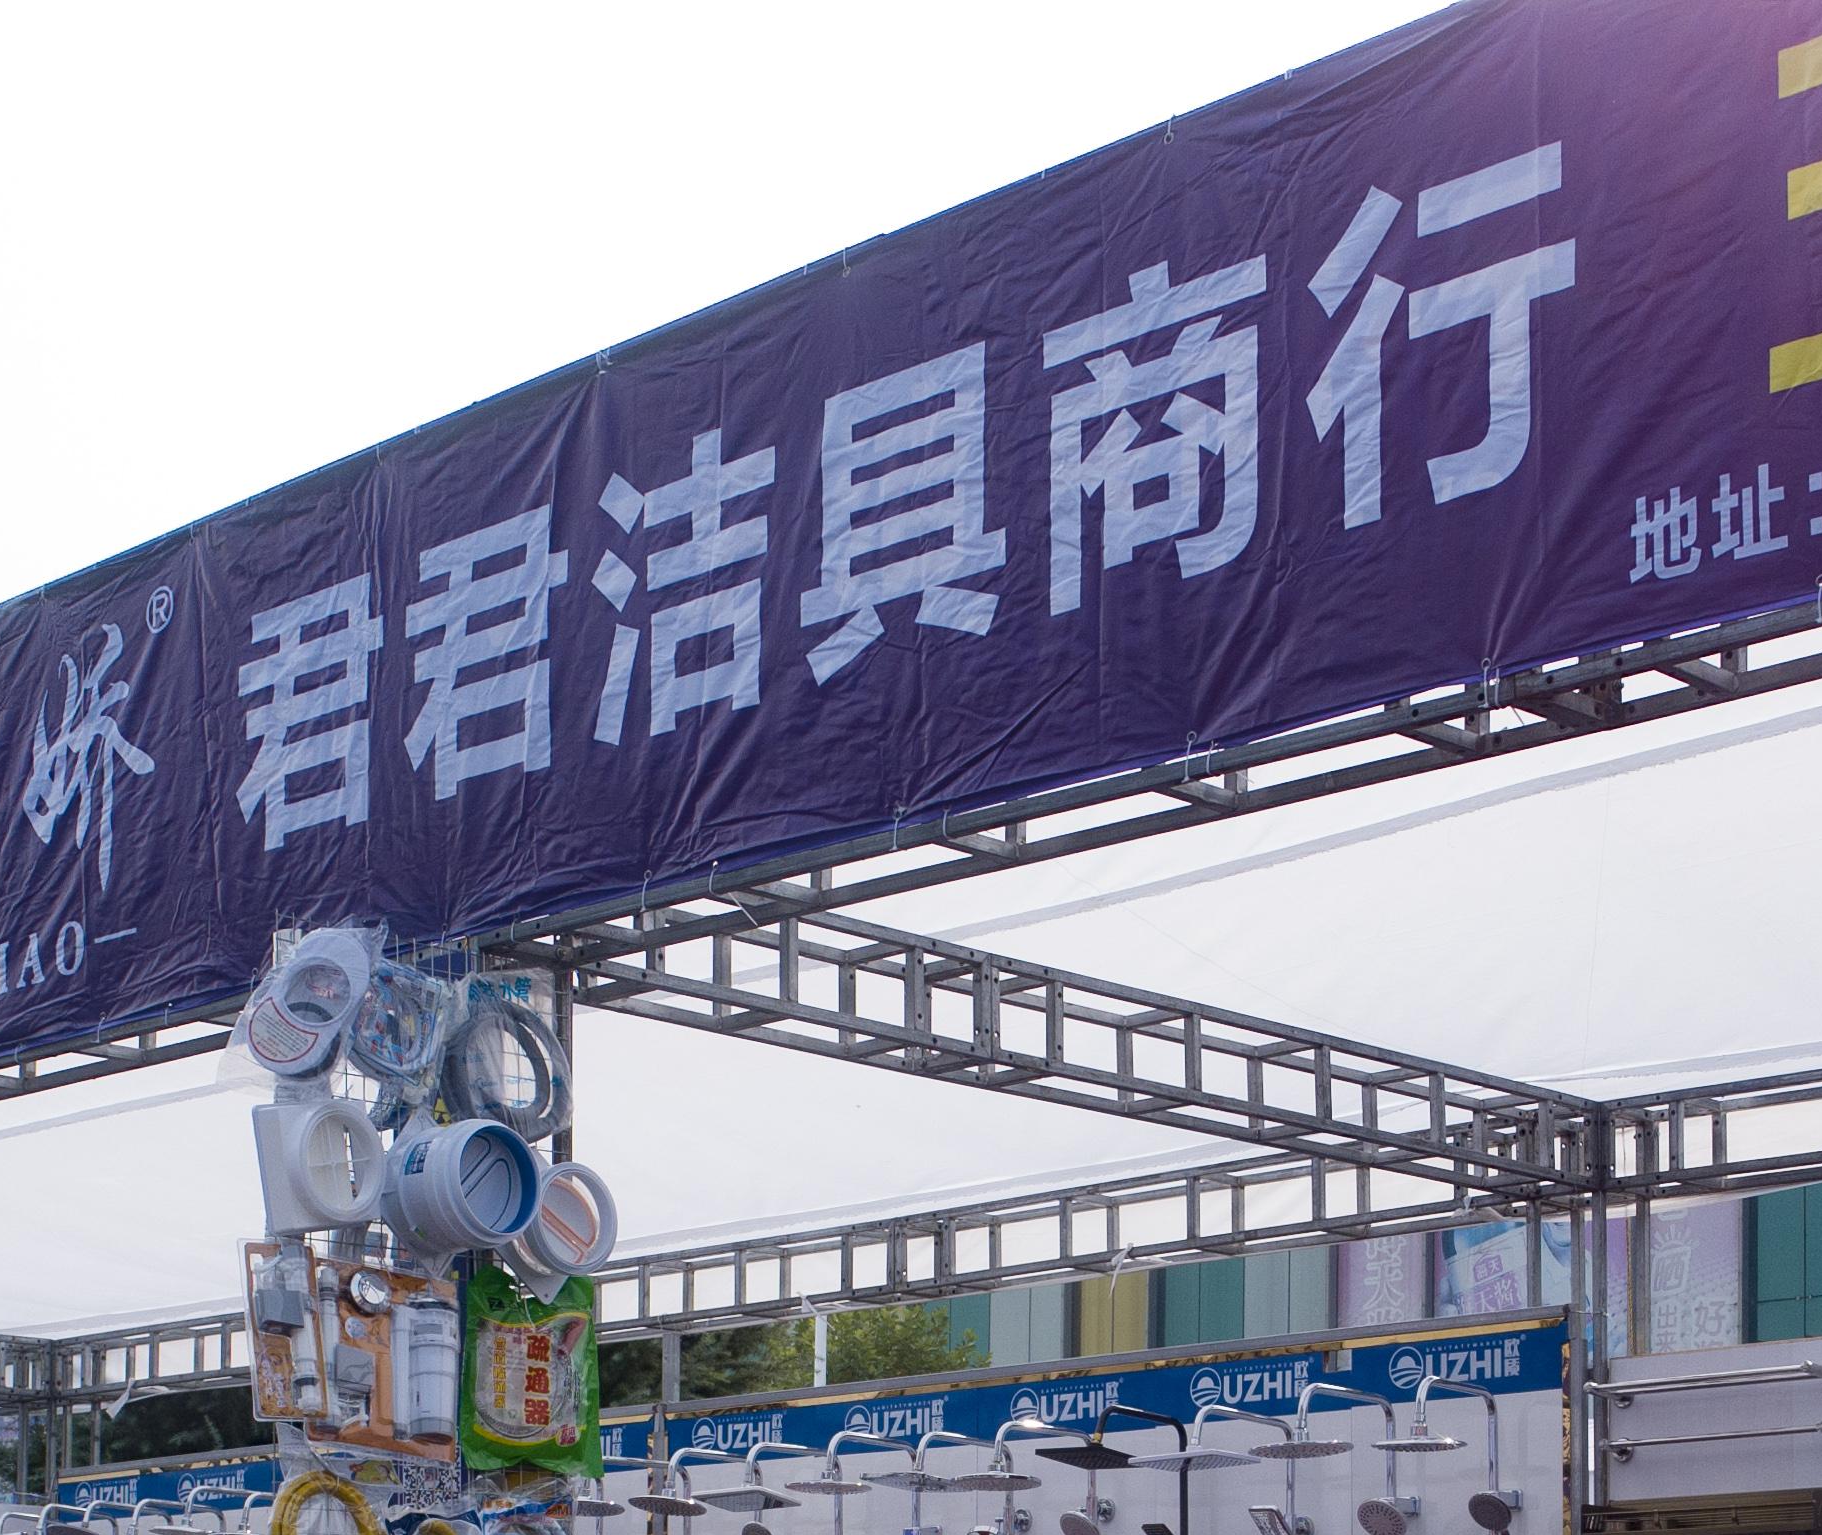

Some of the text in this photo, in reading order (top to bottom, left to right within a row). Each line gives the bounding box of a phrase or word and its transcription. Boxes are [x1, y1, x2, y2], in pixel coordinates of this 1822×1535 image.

[234, 140, 1576, 852] 君君洁具商行
[524, 1334, 553, 1426] 疏通器
